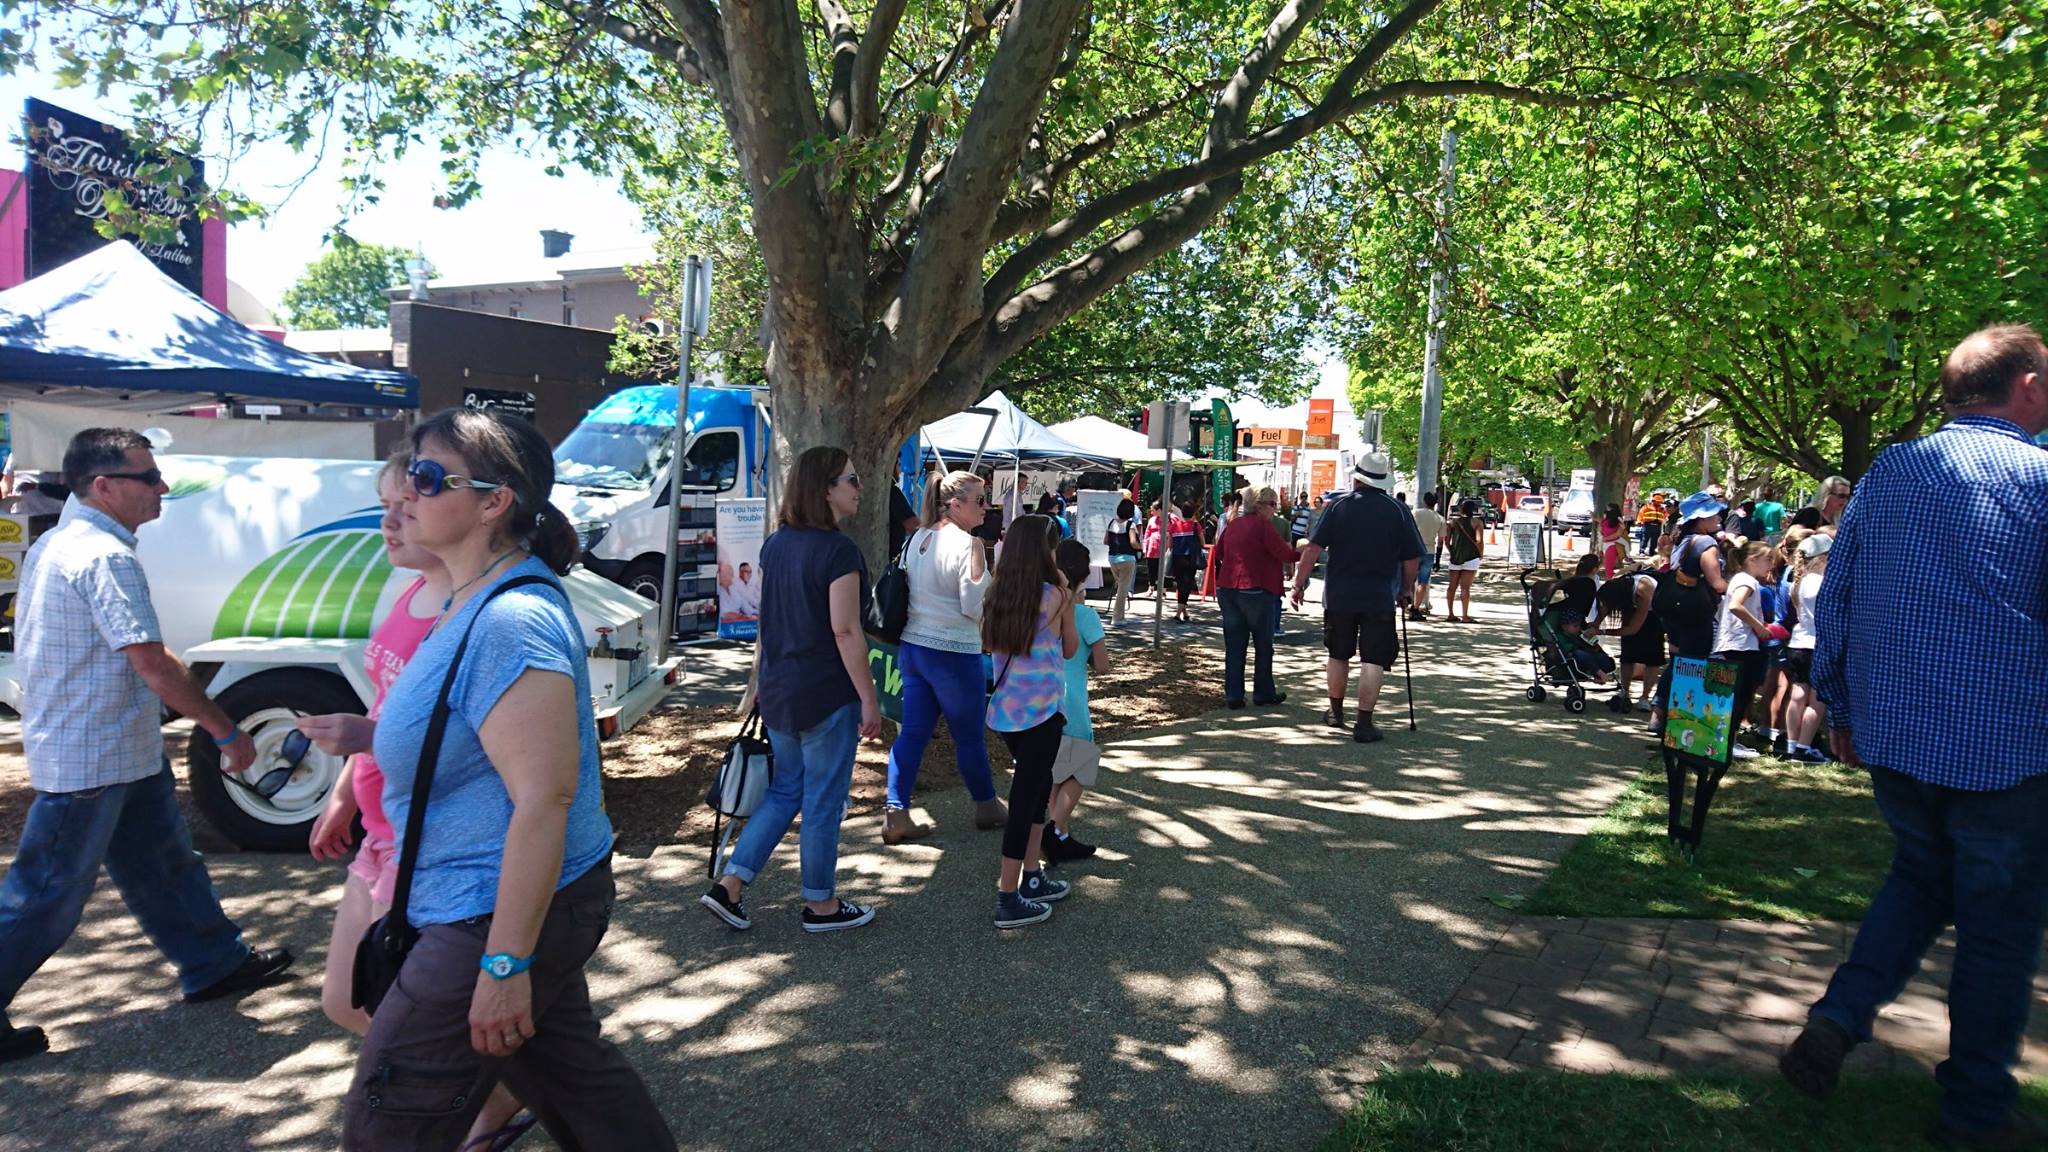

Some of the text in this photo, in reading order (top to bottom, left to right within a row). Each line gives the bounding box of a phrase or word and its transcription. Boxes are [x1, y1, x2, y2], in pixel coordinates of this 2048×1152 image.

[150, 243, 193, 266] Tattoo
[1261, 429, 1281, 440] Fuel
[719, 505, 732, 513] Are
[733, 506, 746, 515] you
[737, 513, 762, 521] trouble
[868, 648, 904, 697] CW
